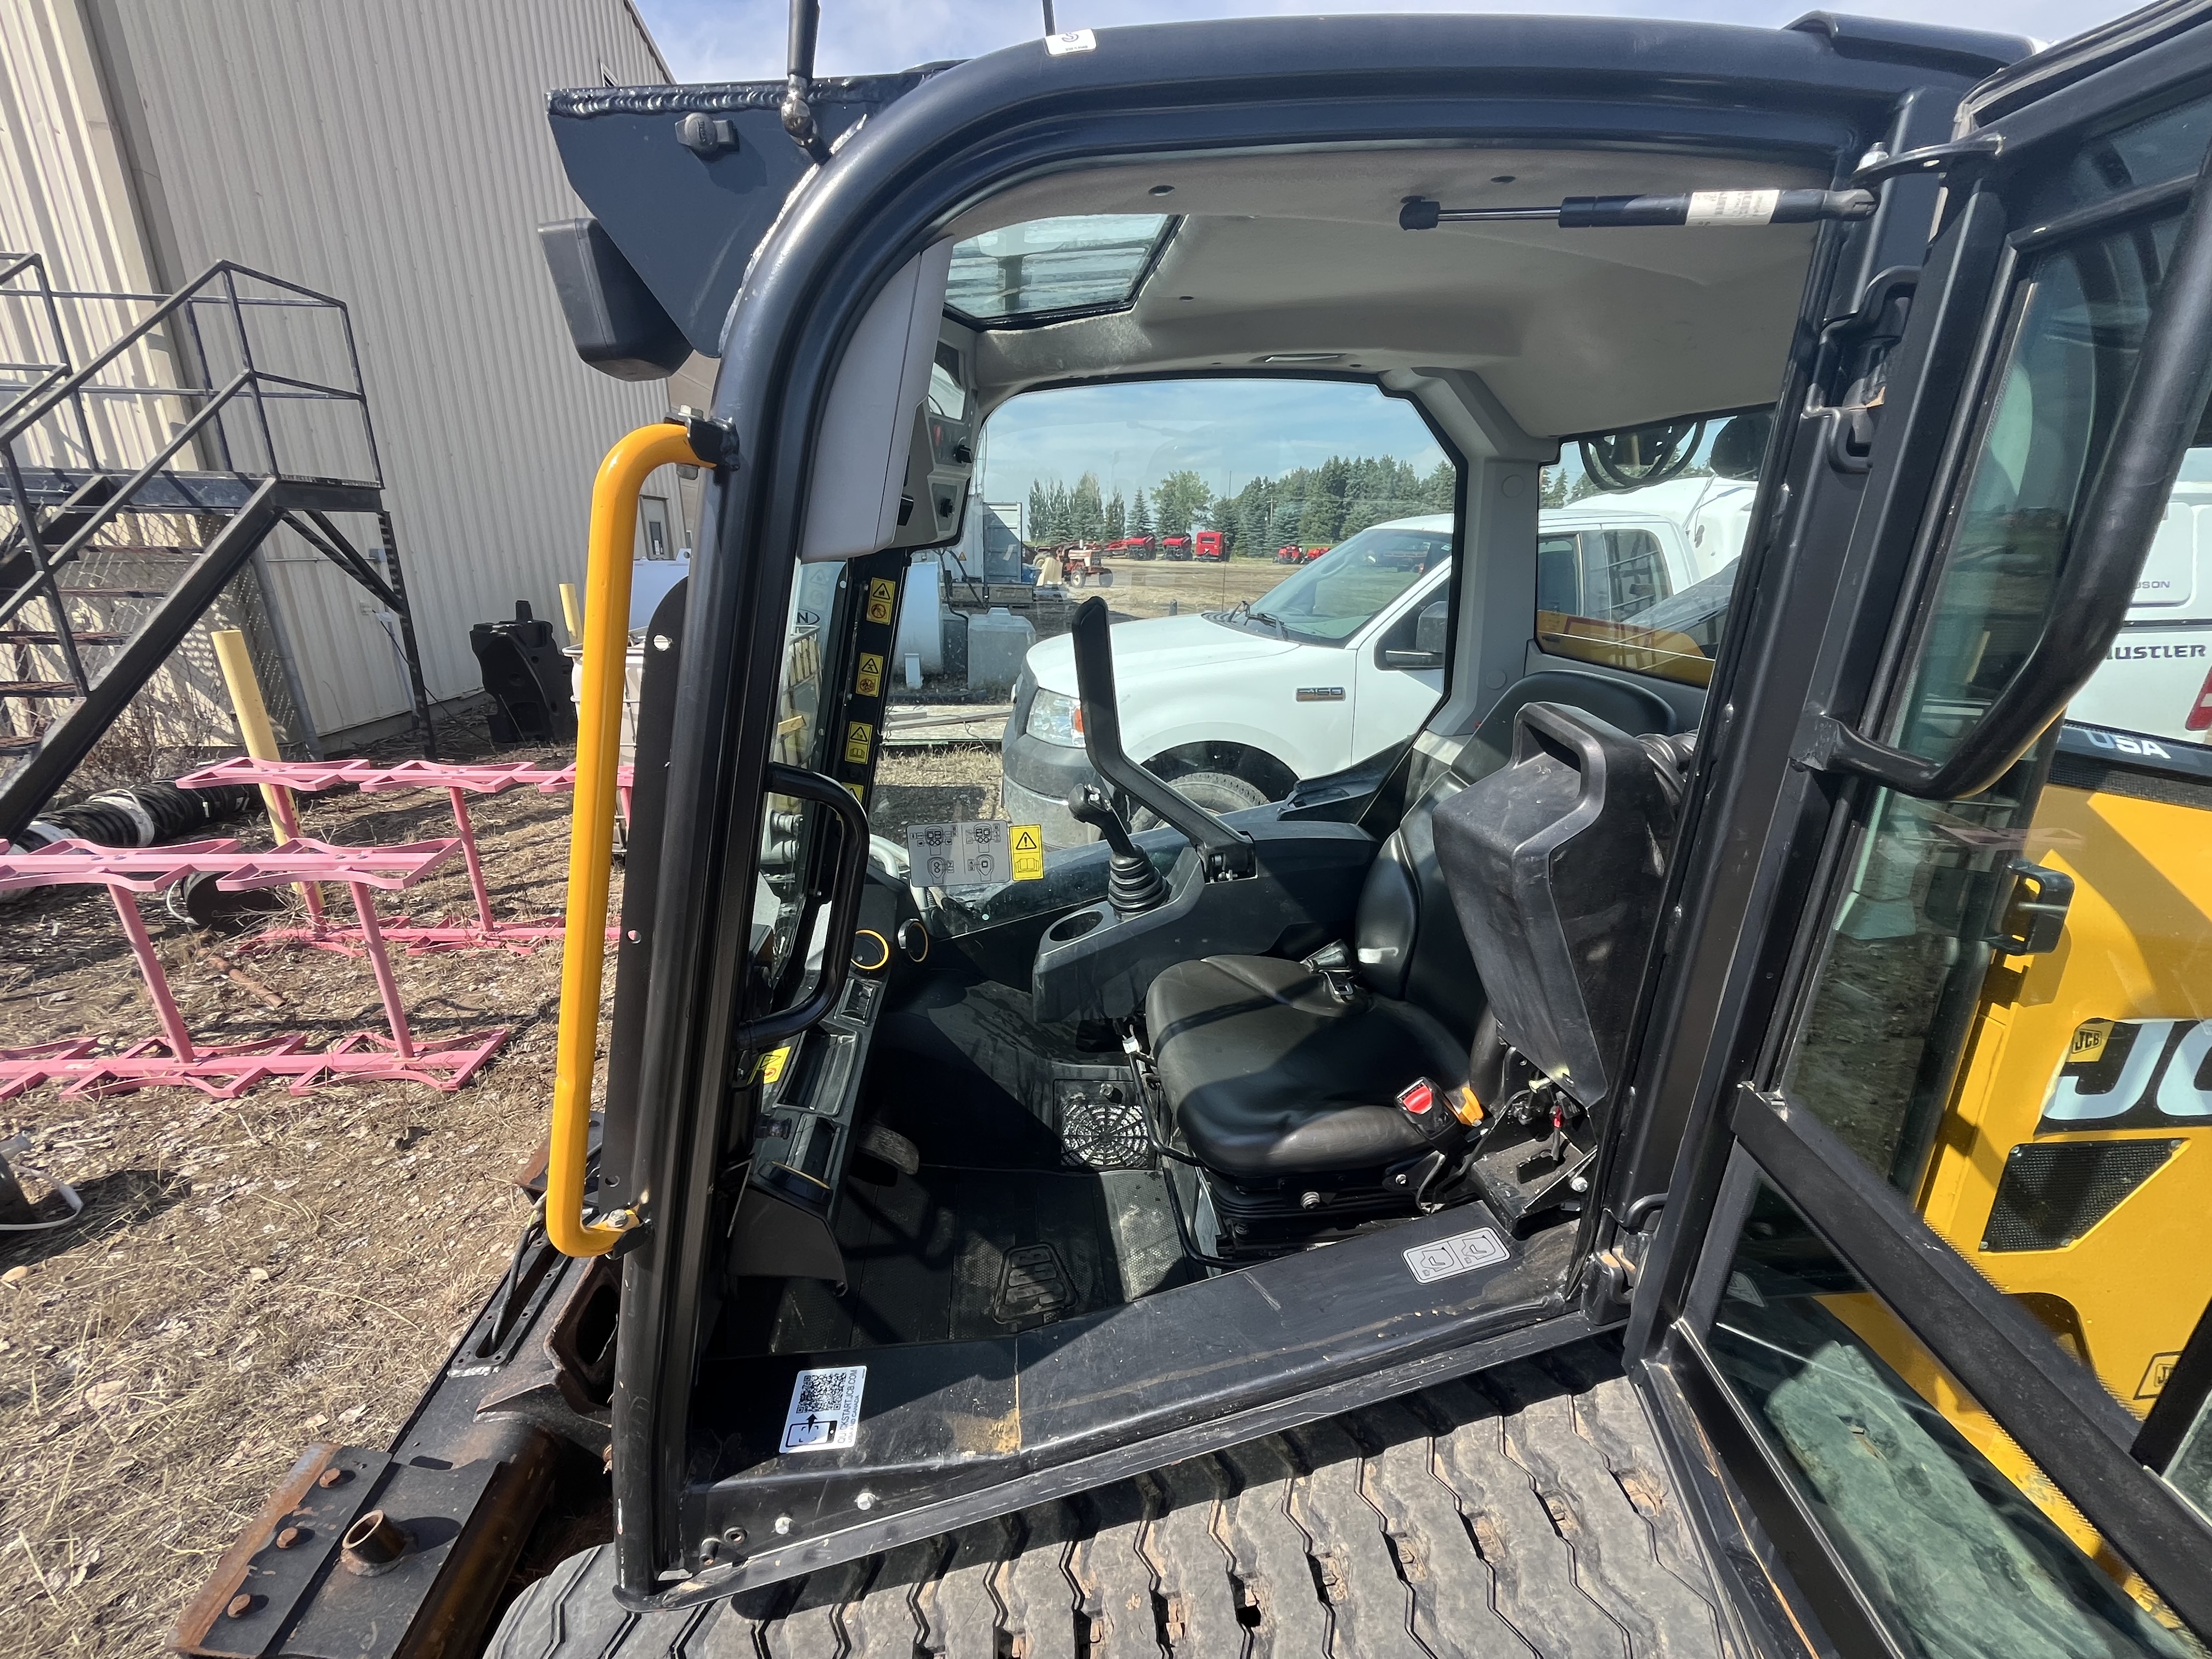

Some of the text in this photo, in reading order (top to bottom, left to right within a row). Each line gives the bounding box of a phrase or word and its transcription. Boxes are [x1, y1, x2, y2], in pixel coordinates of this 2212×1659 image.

[2084, 730, 2171, 759] USA
[2074, 1030, 2100, 1051] JCB
[851, 1395, 860, 1418] CANADA
